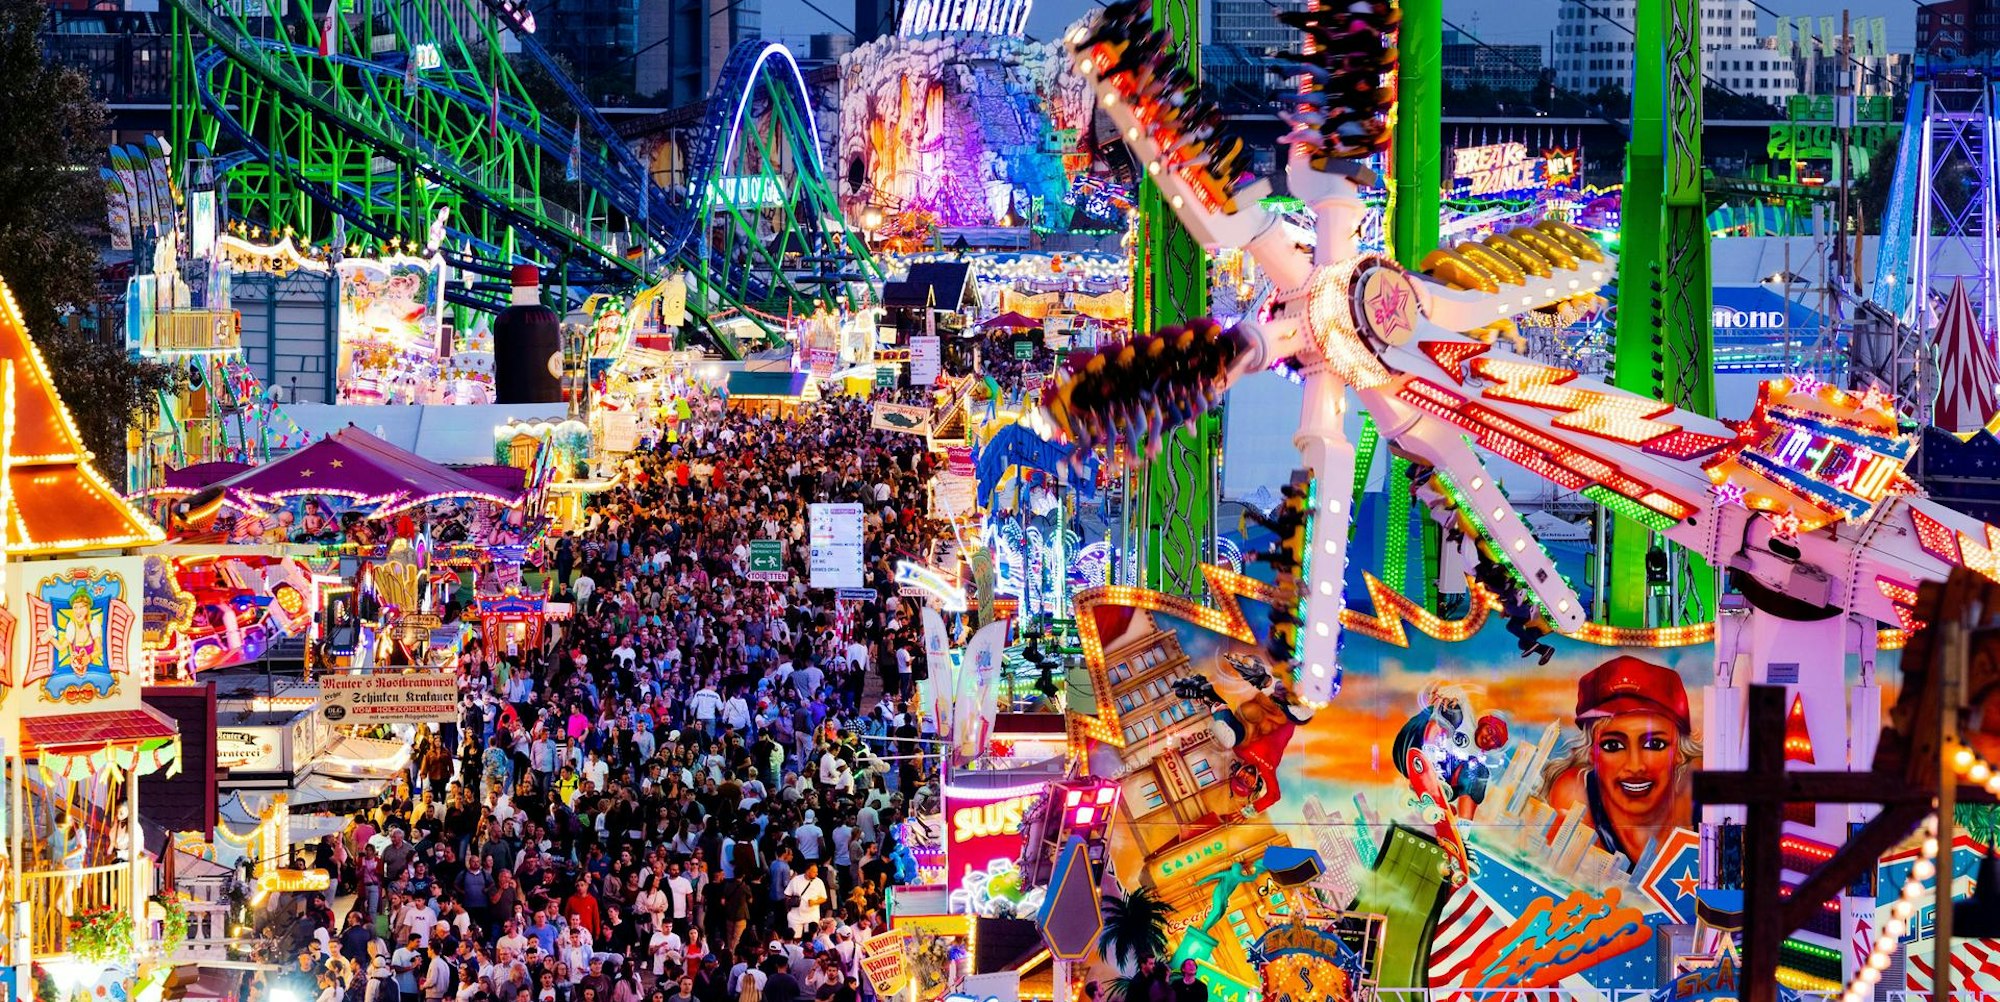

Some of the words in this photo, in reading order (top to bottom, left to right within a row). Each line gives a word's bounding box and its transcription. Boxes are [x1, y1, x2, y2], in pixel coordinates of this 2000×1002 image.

[1456, 143, 1526, 175] BREAK
[1470, 160, 1536, 194] DANCE
[375, 678, 454, 688] Rostbratwurst
[352, 691, 399, 705] Schinken
[405, 691, 454, 702] Krakauer
[353, 706, 372, 714] VOM
[376, 705, 454, 713] HOLZKOHLENGRILL
[1164, 751, 1187, 795] HOTEL
[1161, 841, 1223, 875] CASINO
[868, 934, 902, 951] Baum-
[1264, 912, 1338, 958] SKATER
[866, 954, 900, 973] Baum-
[870, 967, 902, 983] striezel
[1676, 957, 1738, 998] SKA
